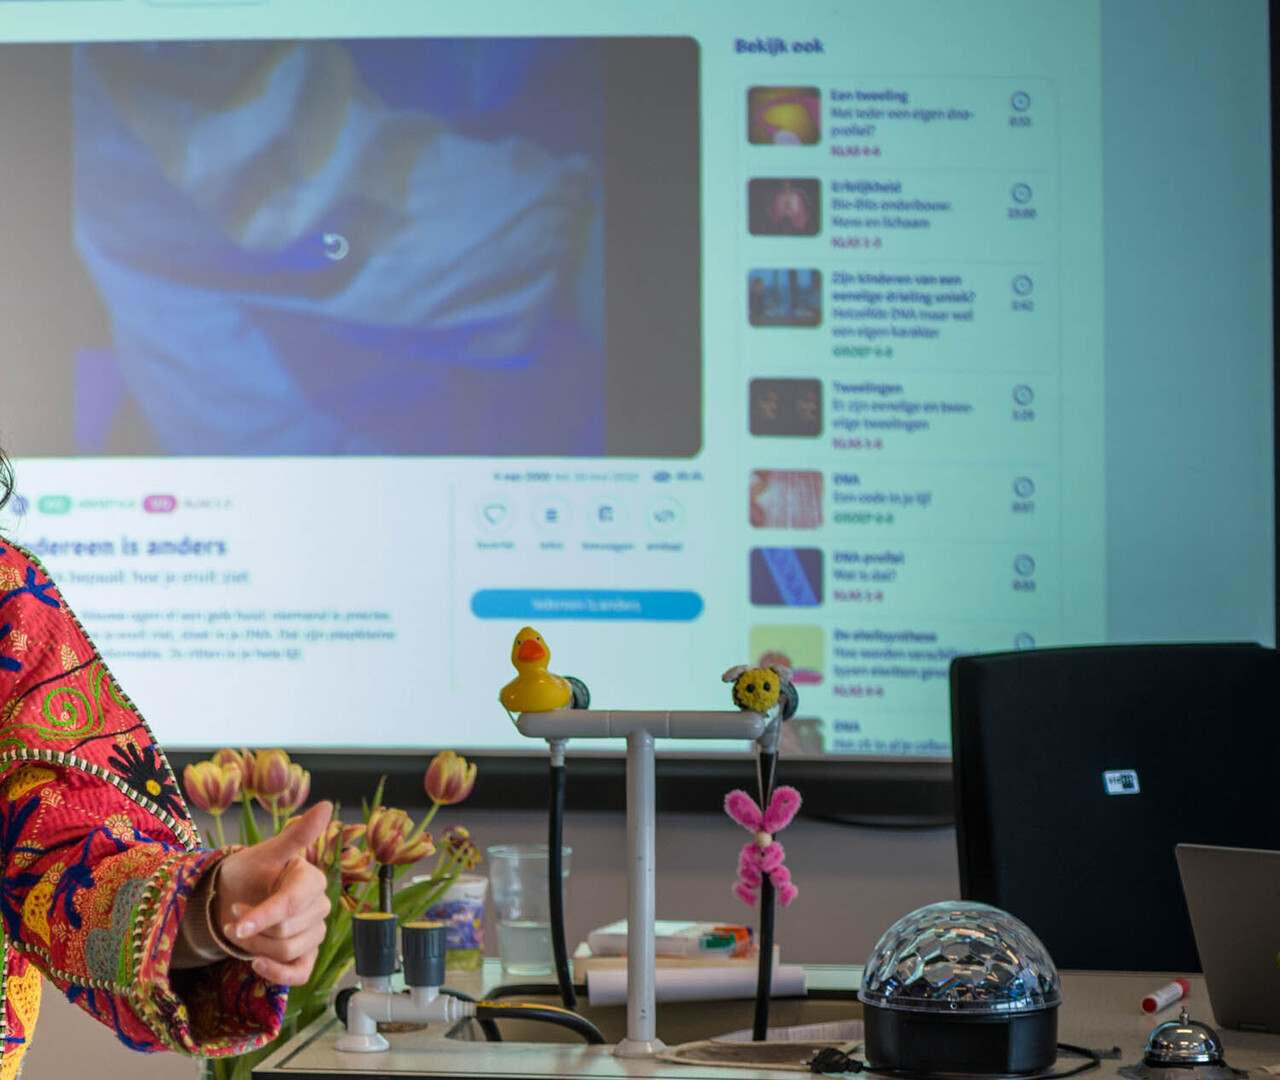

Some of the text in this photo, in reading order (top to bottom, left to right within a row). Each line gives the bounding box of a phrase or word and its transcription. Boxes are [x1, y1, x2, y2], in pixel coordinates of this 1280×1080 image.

[734, 36, 825, 57] Bekijk ook
[855, 90, 909, 104] tweeling
[832, 381, 903, 397] Tweelingen
[833, 473, 860, 485] DNA
[121, 535, 139, 556] is
[146, 535, 227, 556] anders
